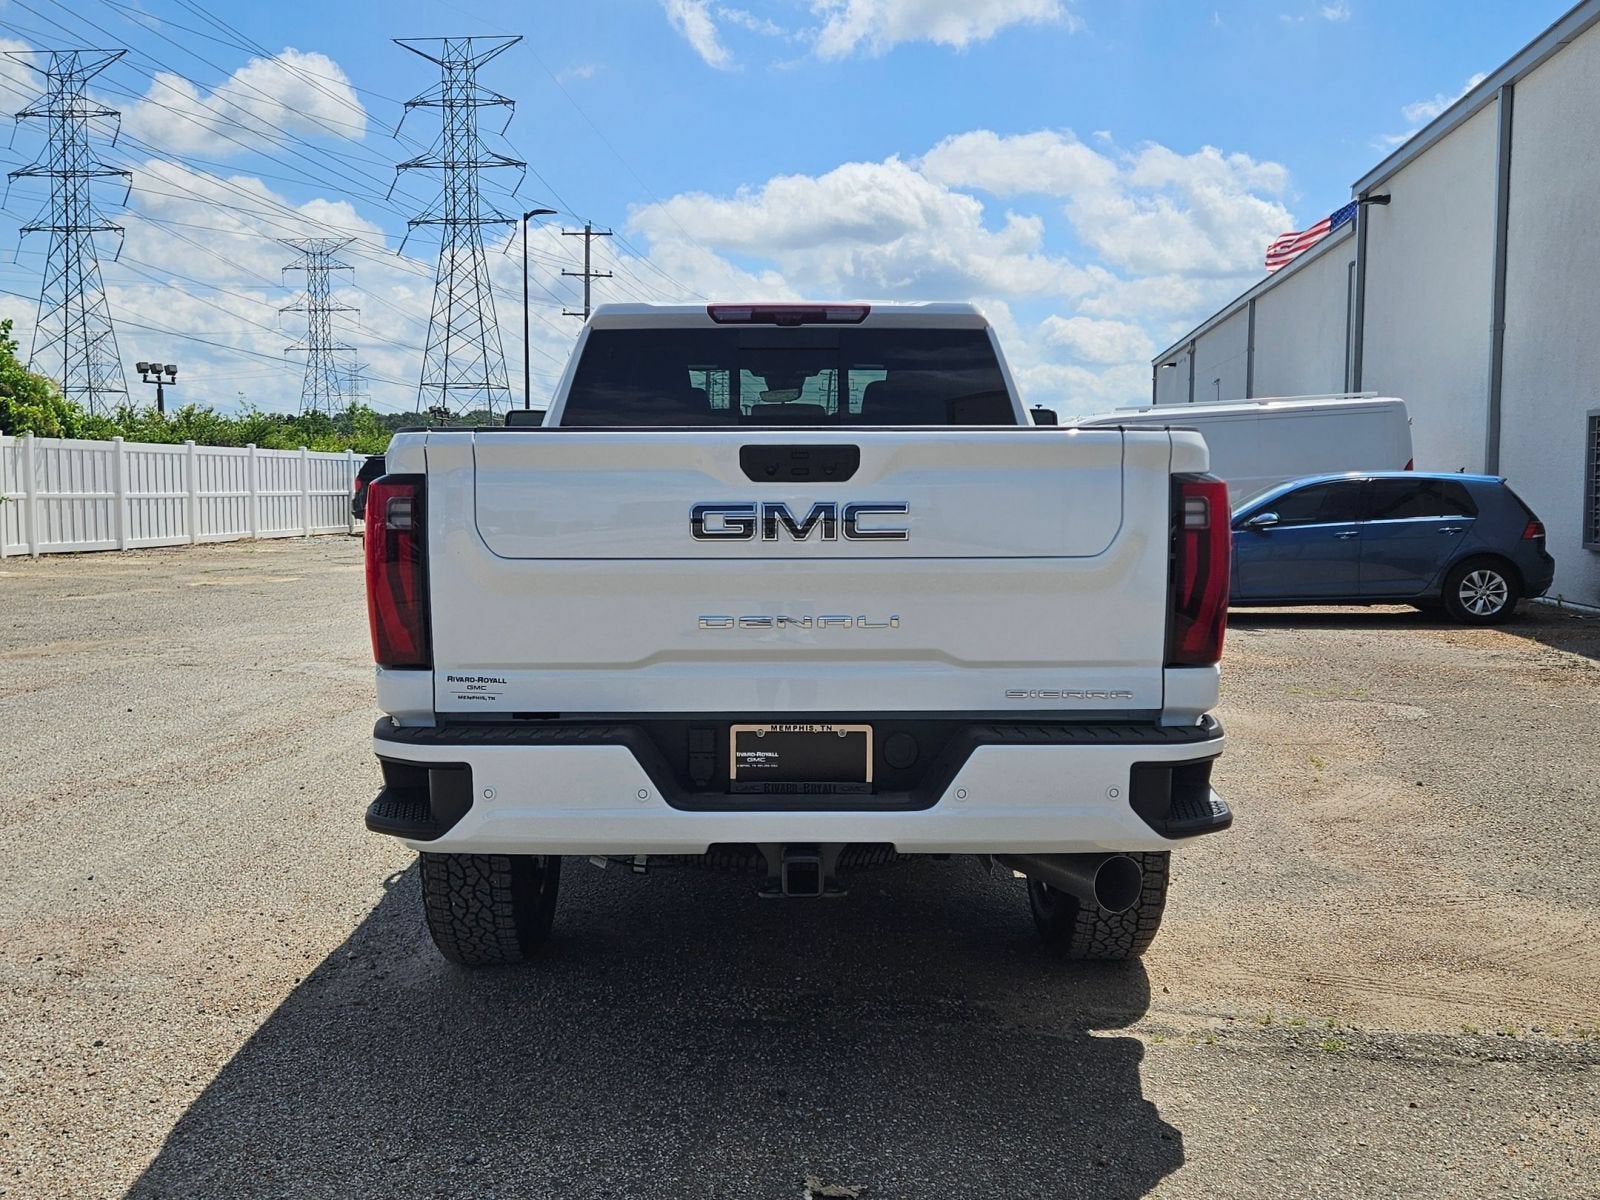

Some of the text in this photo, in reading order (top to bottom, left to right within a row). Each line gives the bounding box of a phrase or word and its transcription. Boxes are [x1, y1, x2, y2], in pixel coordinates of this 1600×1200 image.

[690, 501, 909, 541] GMC
[698, 614, 900, 629] DENALI
[1005, 690, 1133, 699] SIERRA
[770, 725, 817, 733] MEMPHIS,
